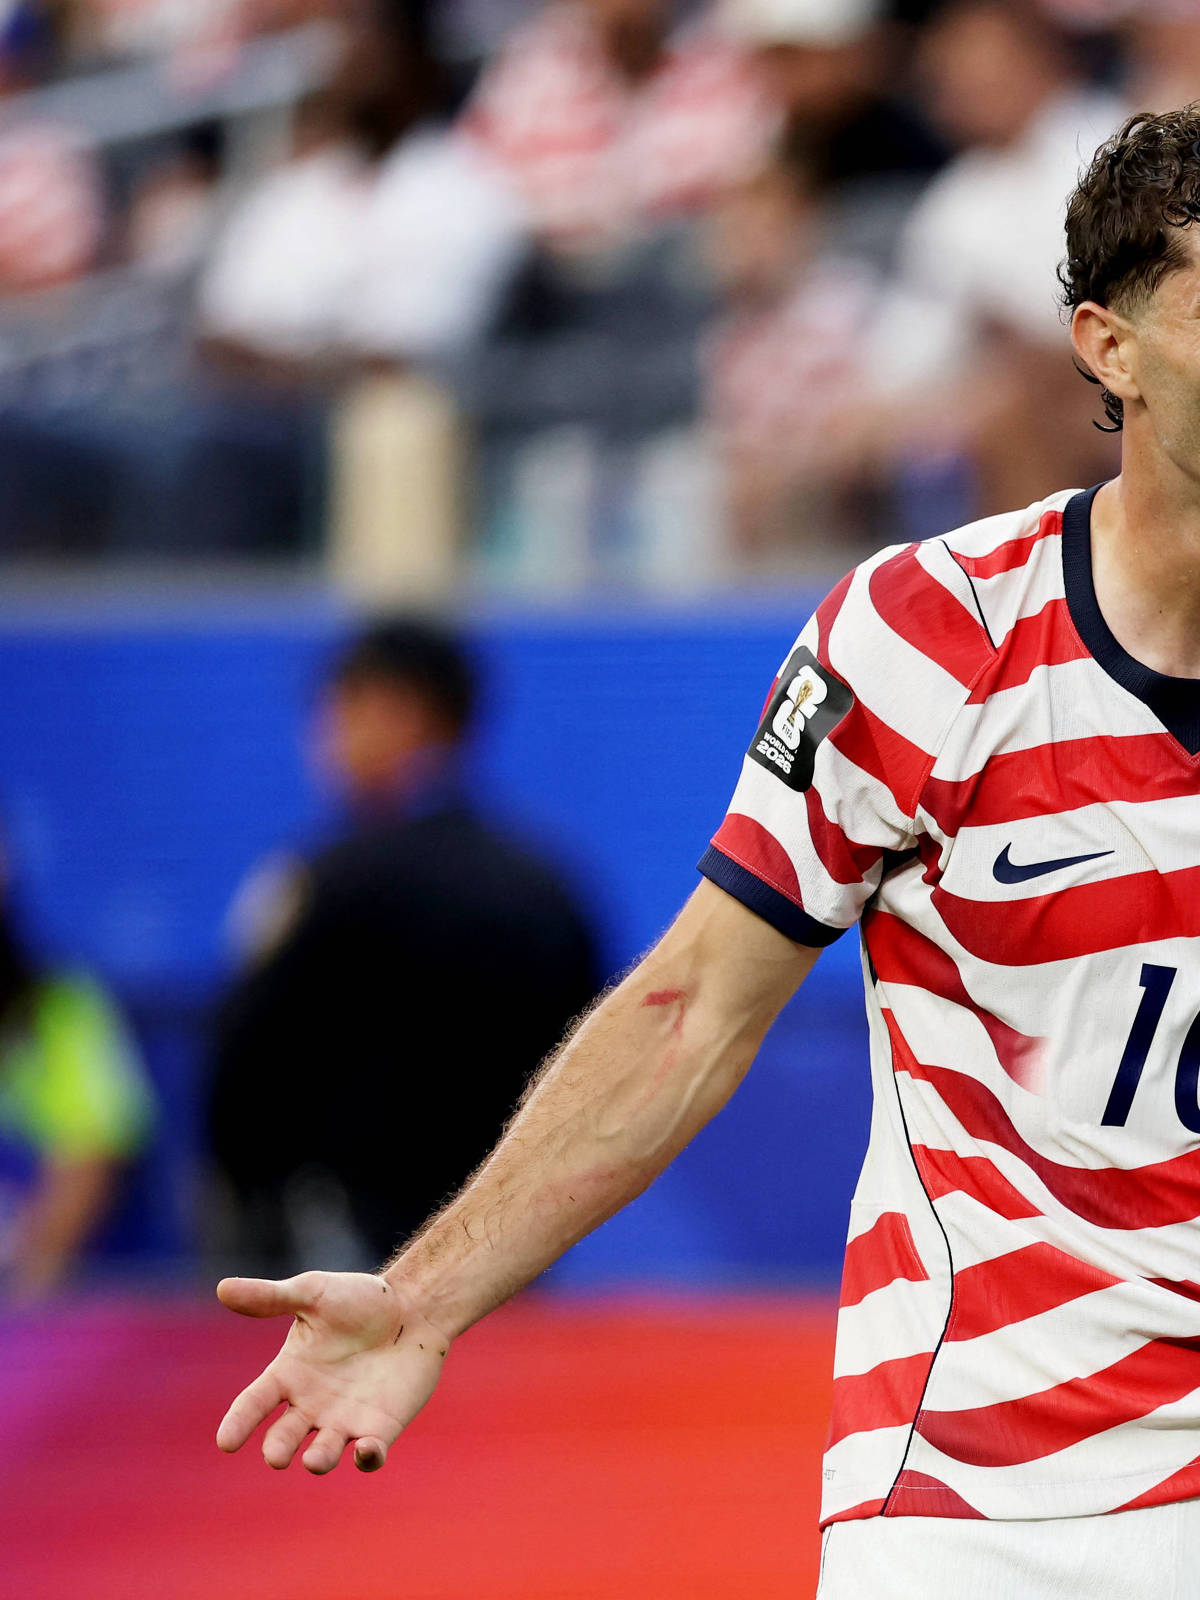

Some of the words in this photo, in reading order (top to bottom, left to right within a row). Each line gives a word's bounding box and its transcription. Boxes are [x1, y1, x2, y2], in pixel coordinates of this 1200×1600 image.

[763, 731, 786, 754] WORLD
[784, 749, 795, 763] CUP
[782, 723, 793, 740] FIFA
[756, 740, 792, 774] 2026
